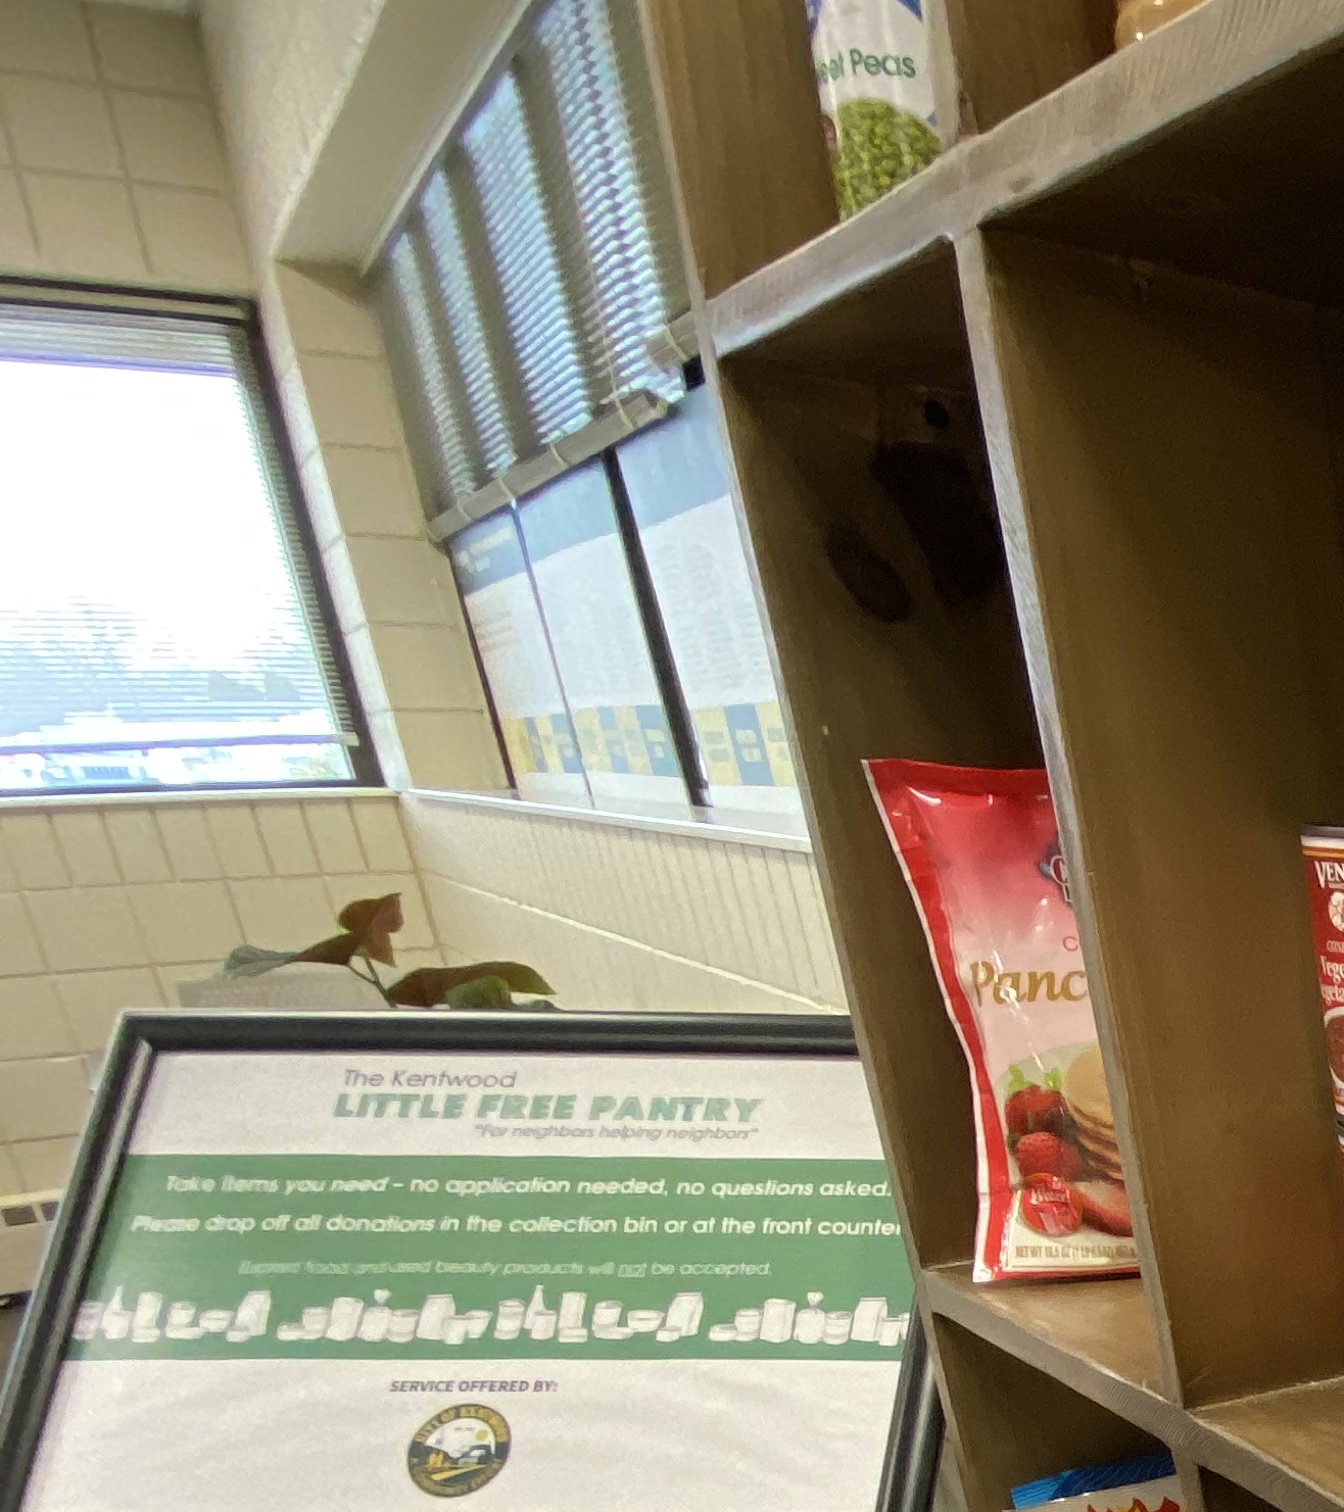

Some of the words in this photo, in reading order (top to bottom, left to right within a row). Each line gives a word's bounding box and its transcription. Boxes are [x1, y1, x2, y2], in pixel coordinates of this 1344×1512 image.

[849, 47, 917, 80] Peas
[970, 959, 1087, 1008] Panc
[343, 1070, 384, 1088] The
[390, 1071, 518, 1089] Kentwood
[333, 1092, 468, 1118] LITTLE
[477, 1094, 577, 1120] FREE
[588, 1096, 763, 1123] PANTRY
[512, 1124, 595, 1141] neighbors
[599, 1124, 662, 1142] helping
[284, 1178, 326, 1196] you
[331, 1176, 391, 1193] need
[410, 1178, 440, 1193] no
[445, 1177, 571, 1197] application
[576, 1178, 669, 1198] needed,
[677, 1182, 705, 1196] no
[711, 1180, 813, 1199] questions
[819, 1181, 892, 1198] asked.
[204, 1214, 255, 1235] drop
[261, 1214, 291, 1232] off
[294, 1214, 321, 1232] all
[326, 1214, 435, 1233] donations
[440, 1216, 460, 1232] in
[466, 1215, 502, 1233] the
[509, 1216, 617, 1234] collection
[624, 1217, 658, 1233] bin
[664, 1219, 688, 1234] or
[692, 1218, 717, 1234] at
[722, 1217, 756, 1234] the
[761, 1217, 812, 1235] front
[390, 1381, 454, 1393] SERVICE
[458, 1381, 529, 1393] OFFERED
[533, 1381, 559, 1393] BY:
